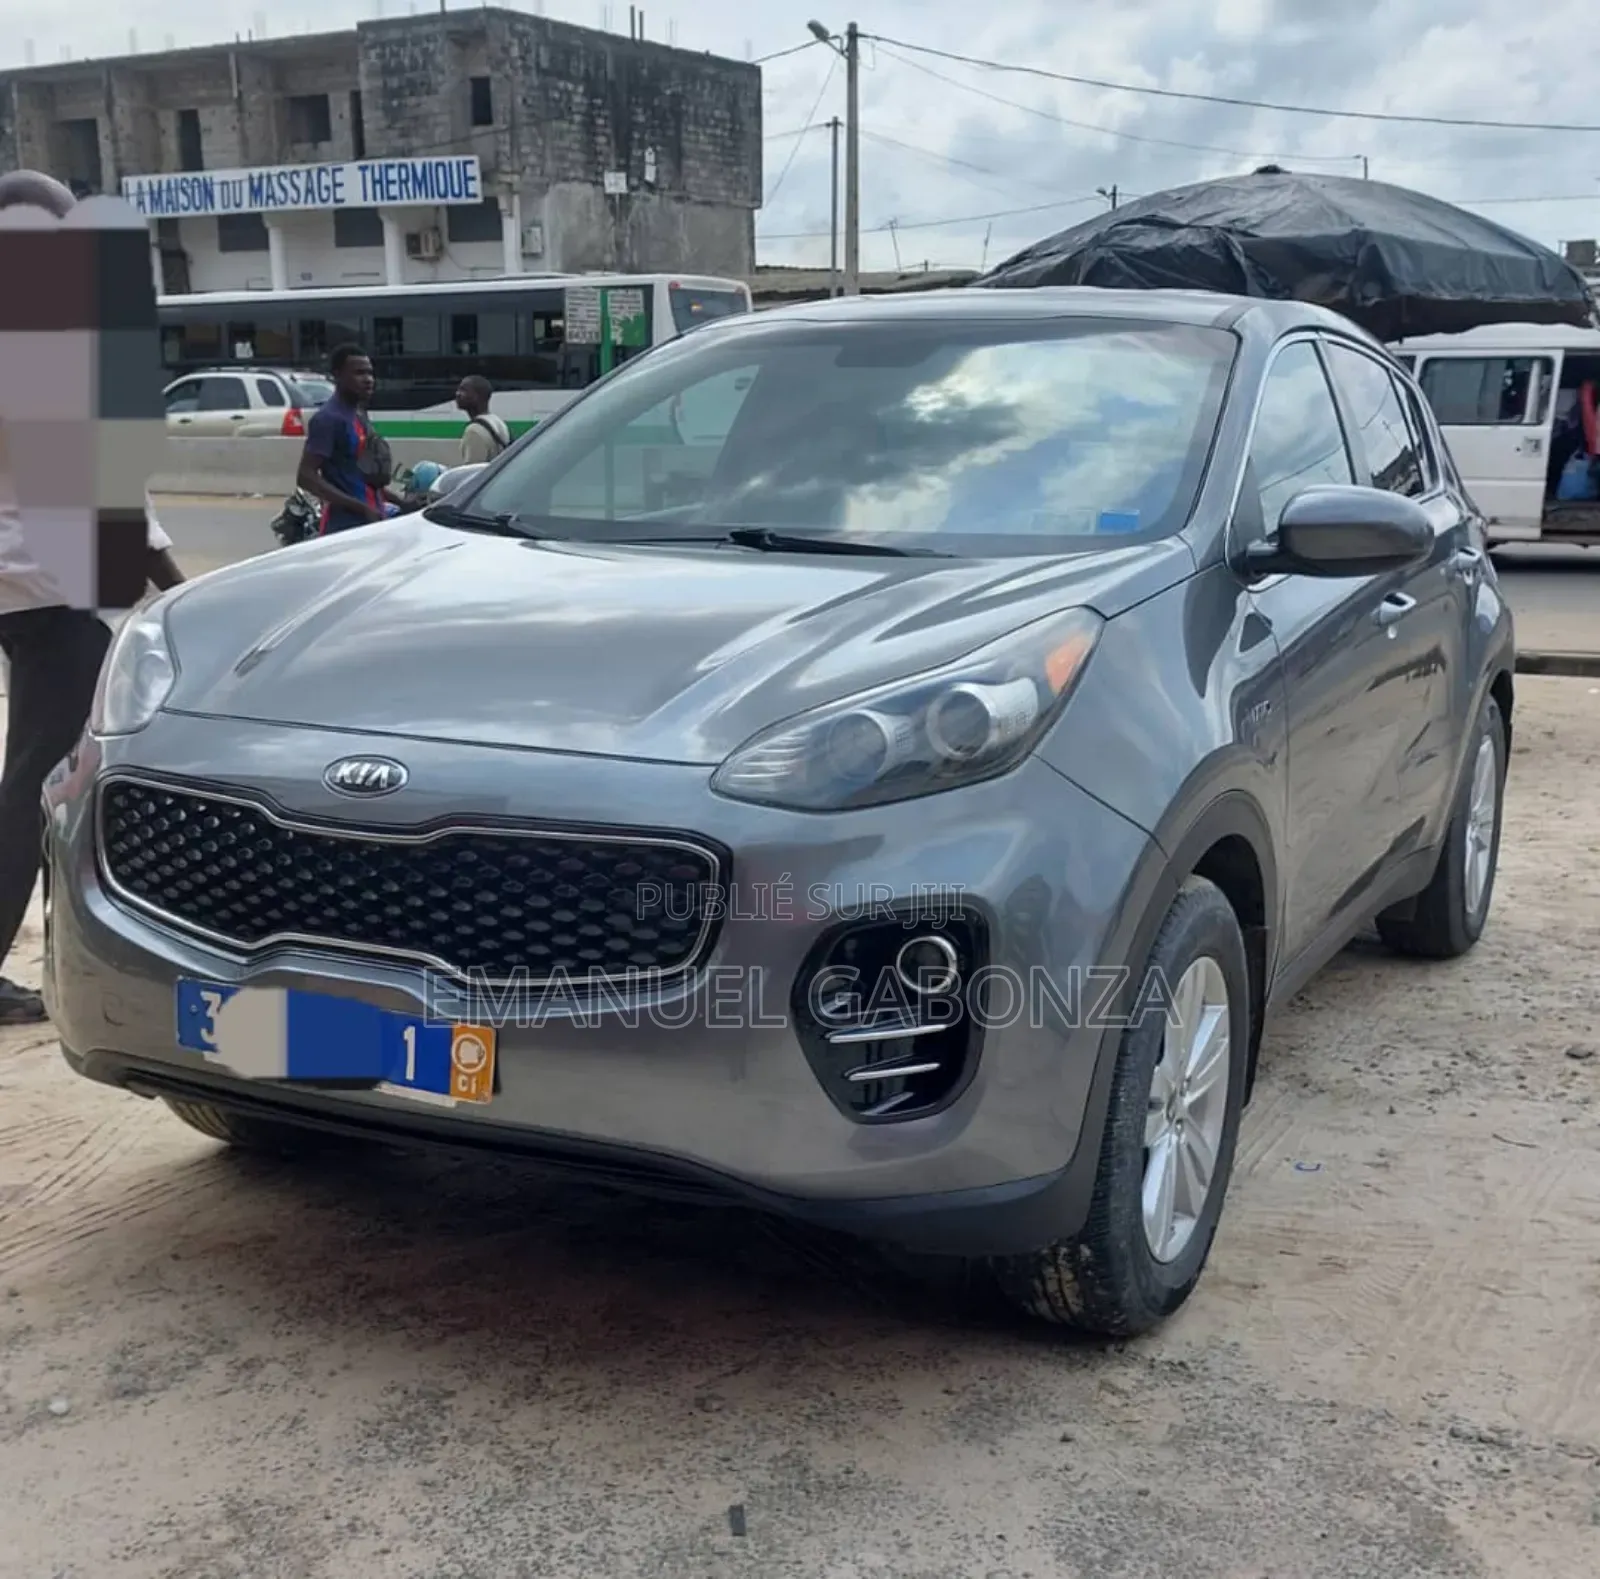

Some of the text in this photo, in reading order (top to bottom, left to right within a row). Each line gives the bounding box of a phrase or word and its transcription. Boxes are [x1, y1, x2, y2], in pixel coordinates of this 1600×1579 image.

[148, 176, 215, 214] MAISON
[220, 179, 243, 209] DU
[248, 167, 346, 208] MASSAGE
[333, 761, 390, 788] KIA
